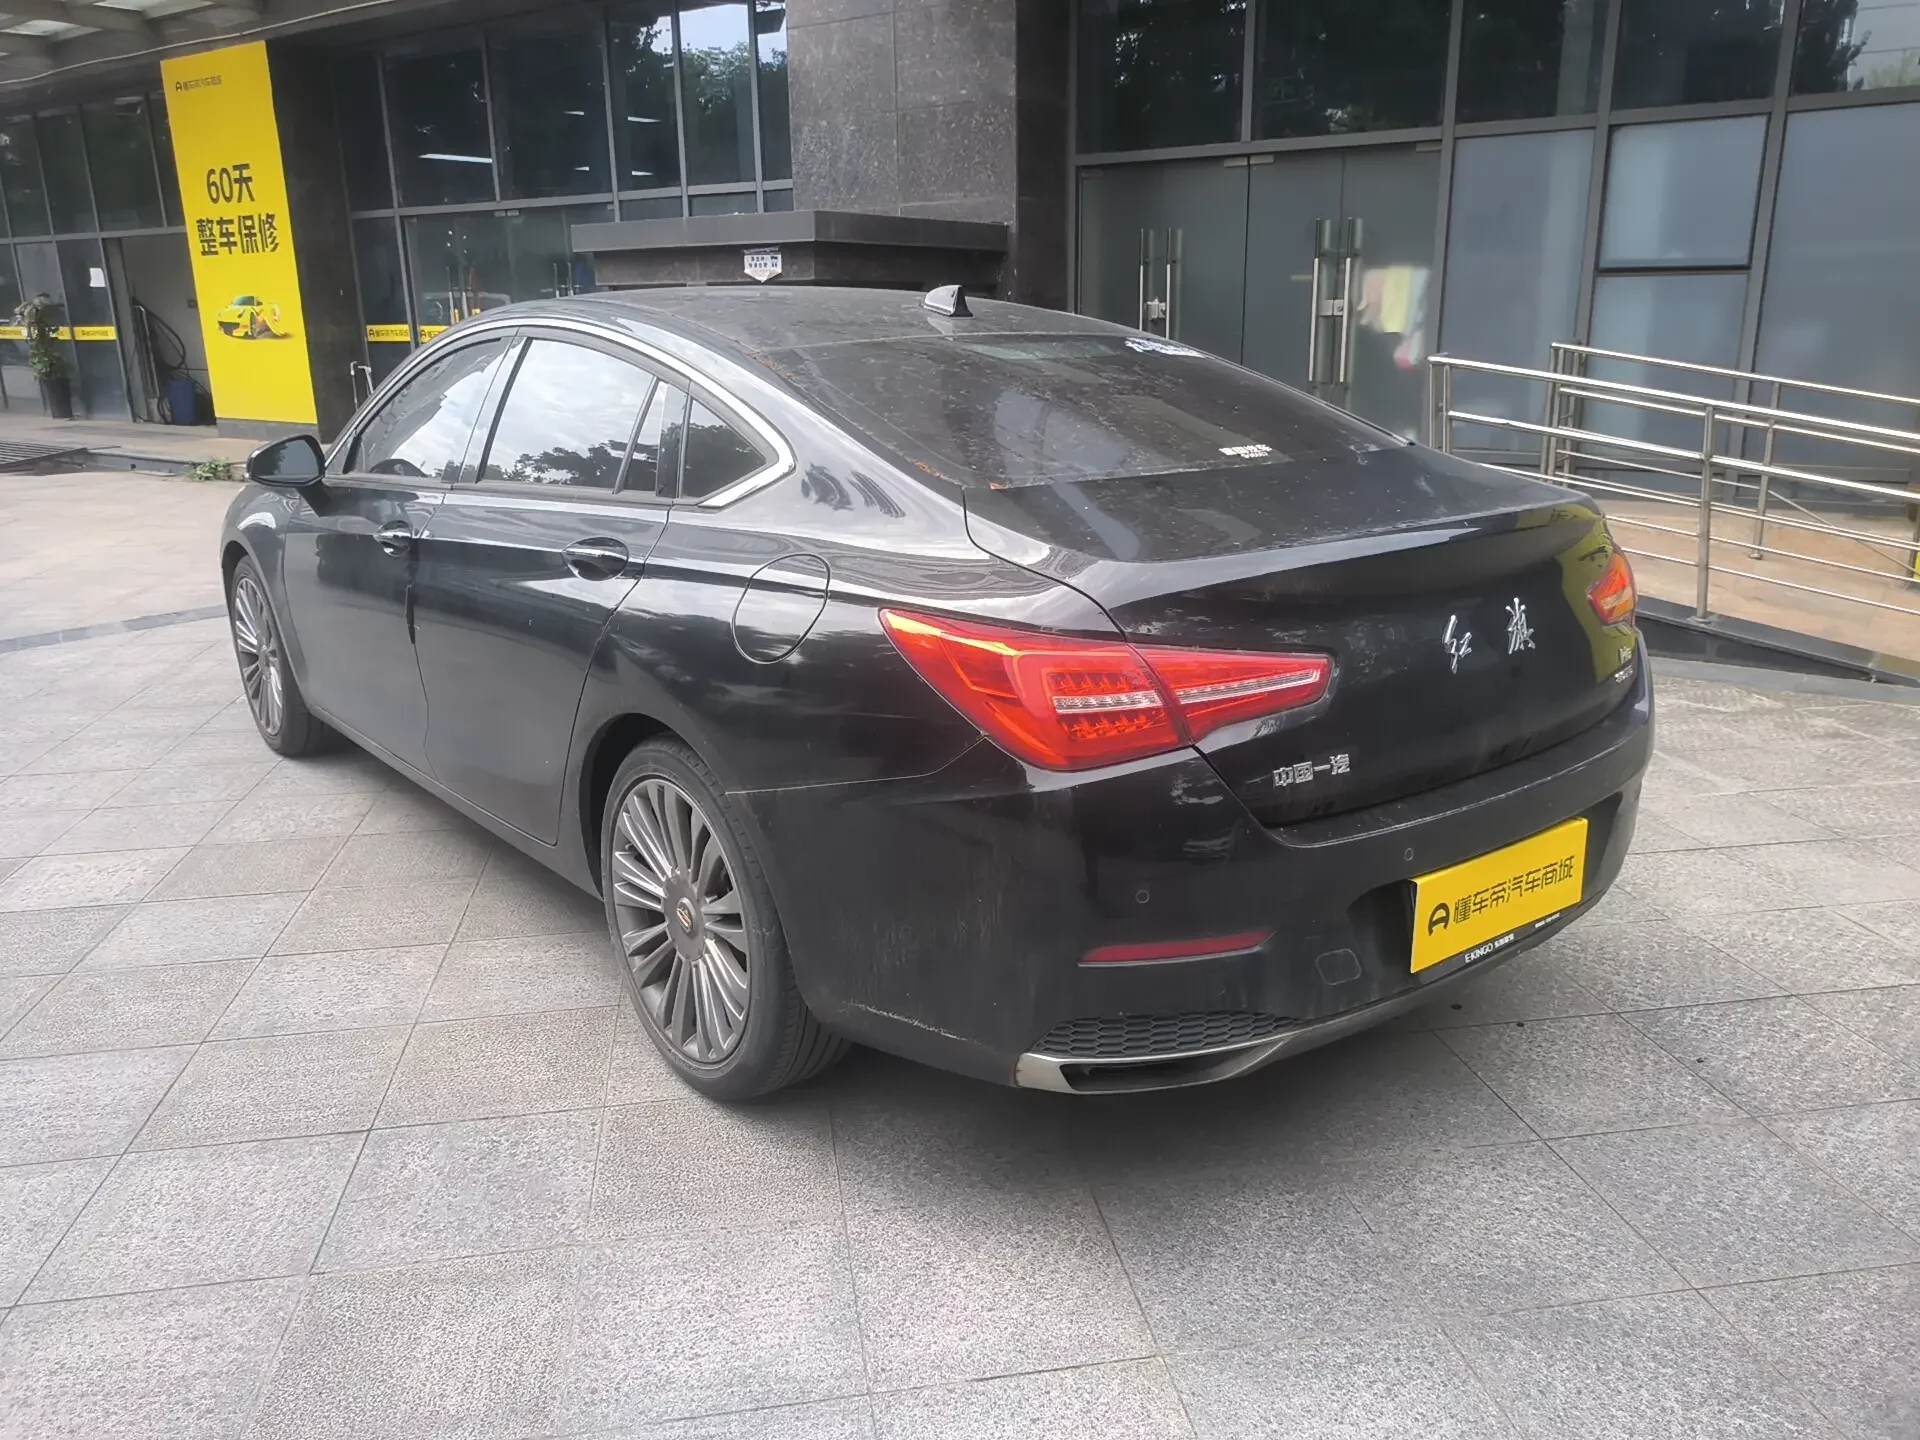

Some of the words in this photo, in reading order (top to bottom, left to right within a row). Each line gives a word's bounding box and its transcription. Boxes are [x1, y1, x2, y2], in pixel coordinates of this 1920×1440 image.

[206, 163, 255, 204] 60天
[196, 213, 279, 256] 整车保修
[1273, 753, 1350, 786] 中国一汽
[1453, 855, 1575, 925] 懂车帝汽车商城
